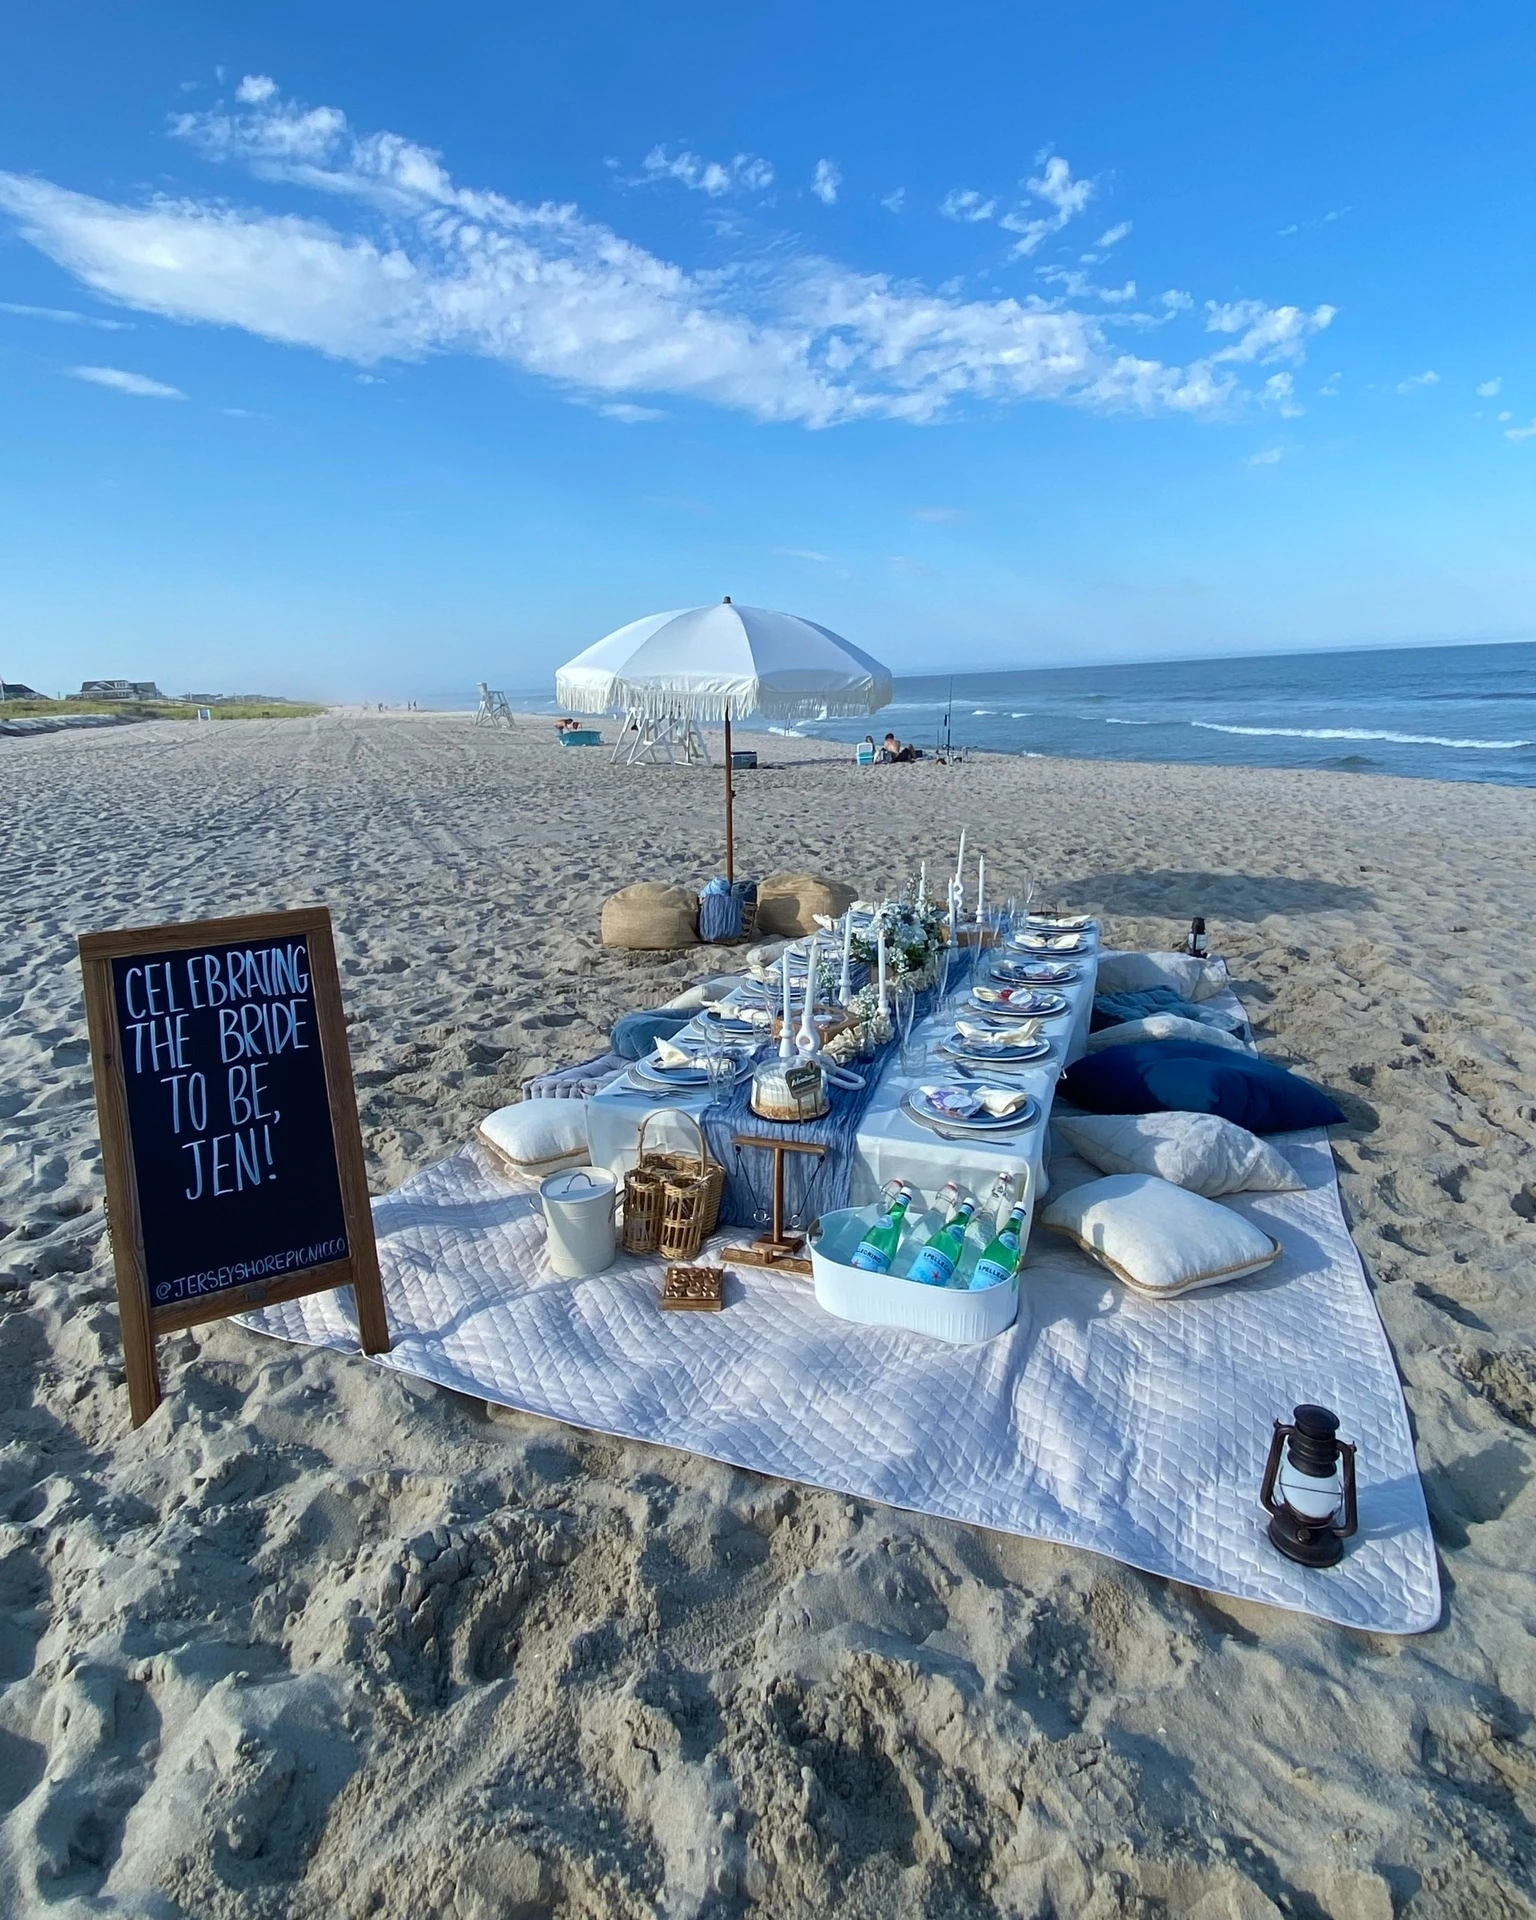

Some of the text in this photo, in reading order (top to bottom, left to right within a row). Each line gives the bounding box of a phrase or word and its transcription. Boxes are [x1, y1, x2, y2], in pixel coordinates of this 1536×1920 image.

[125, 944, 309, 1019] CELEBRATING
[126, 999, 309, 1074] THE BRIDE
[160, 1062, 281, 1134] TO BE,
[181, 1124, 277, 1200] JEN!
[156, 1237, 346, 1300] @JERSEYSHOREPICNICCO
